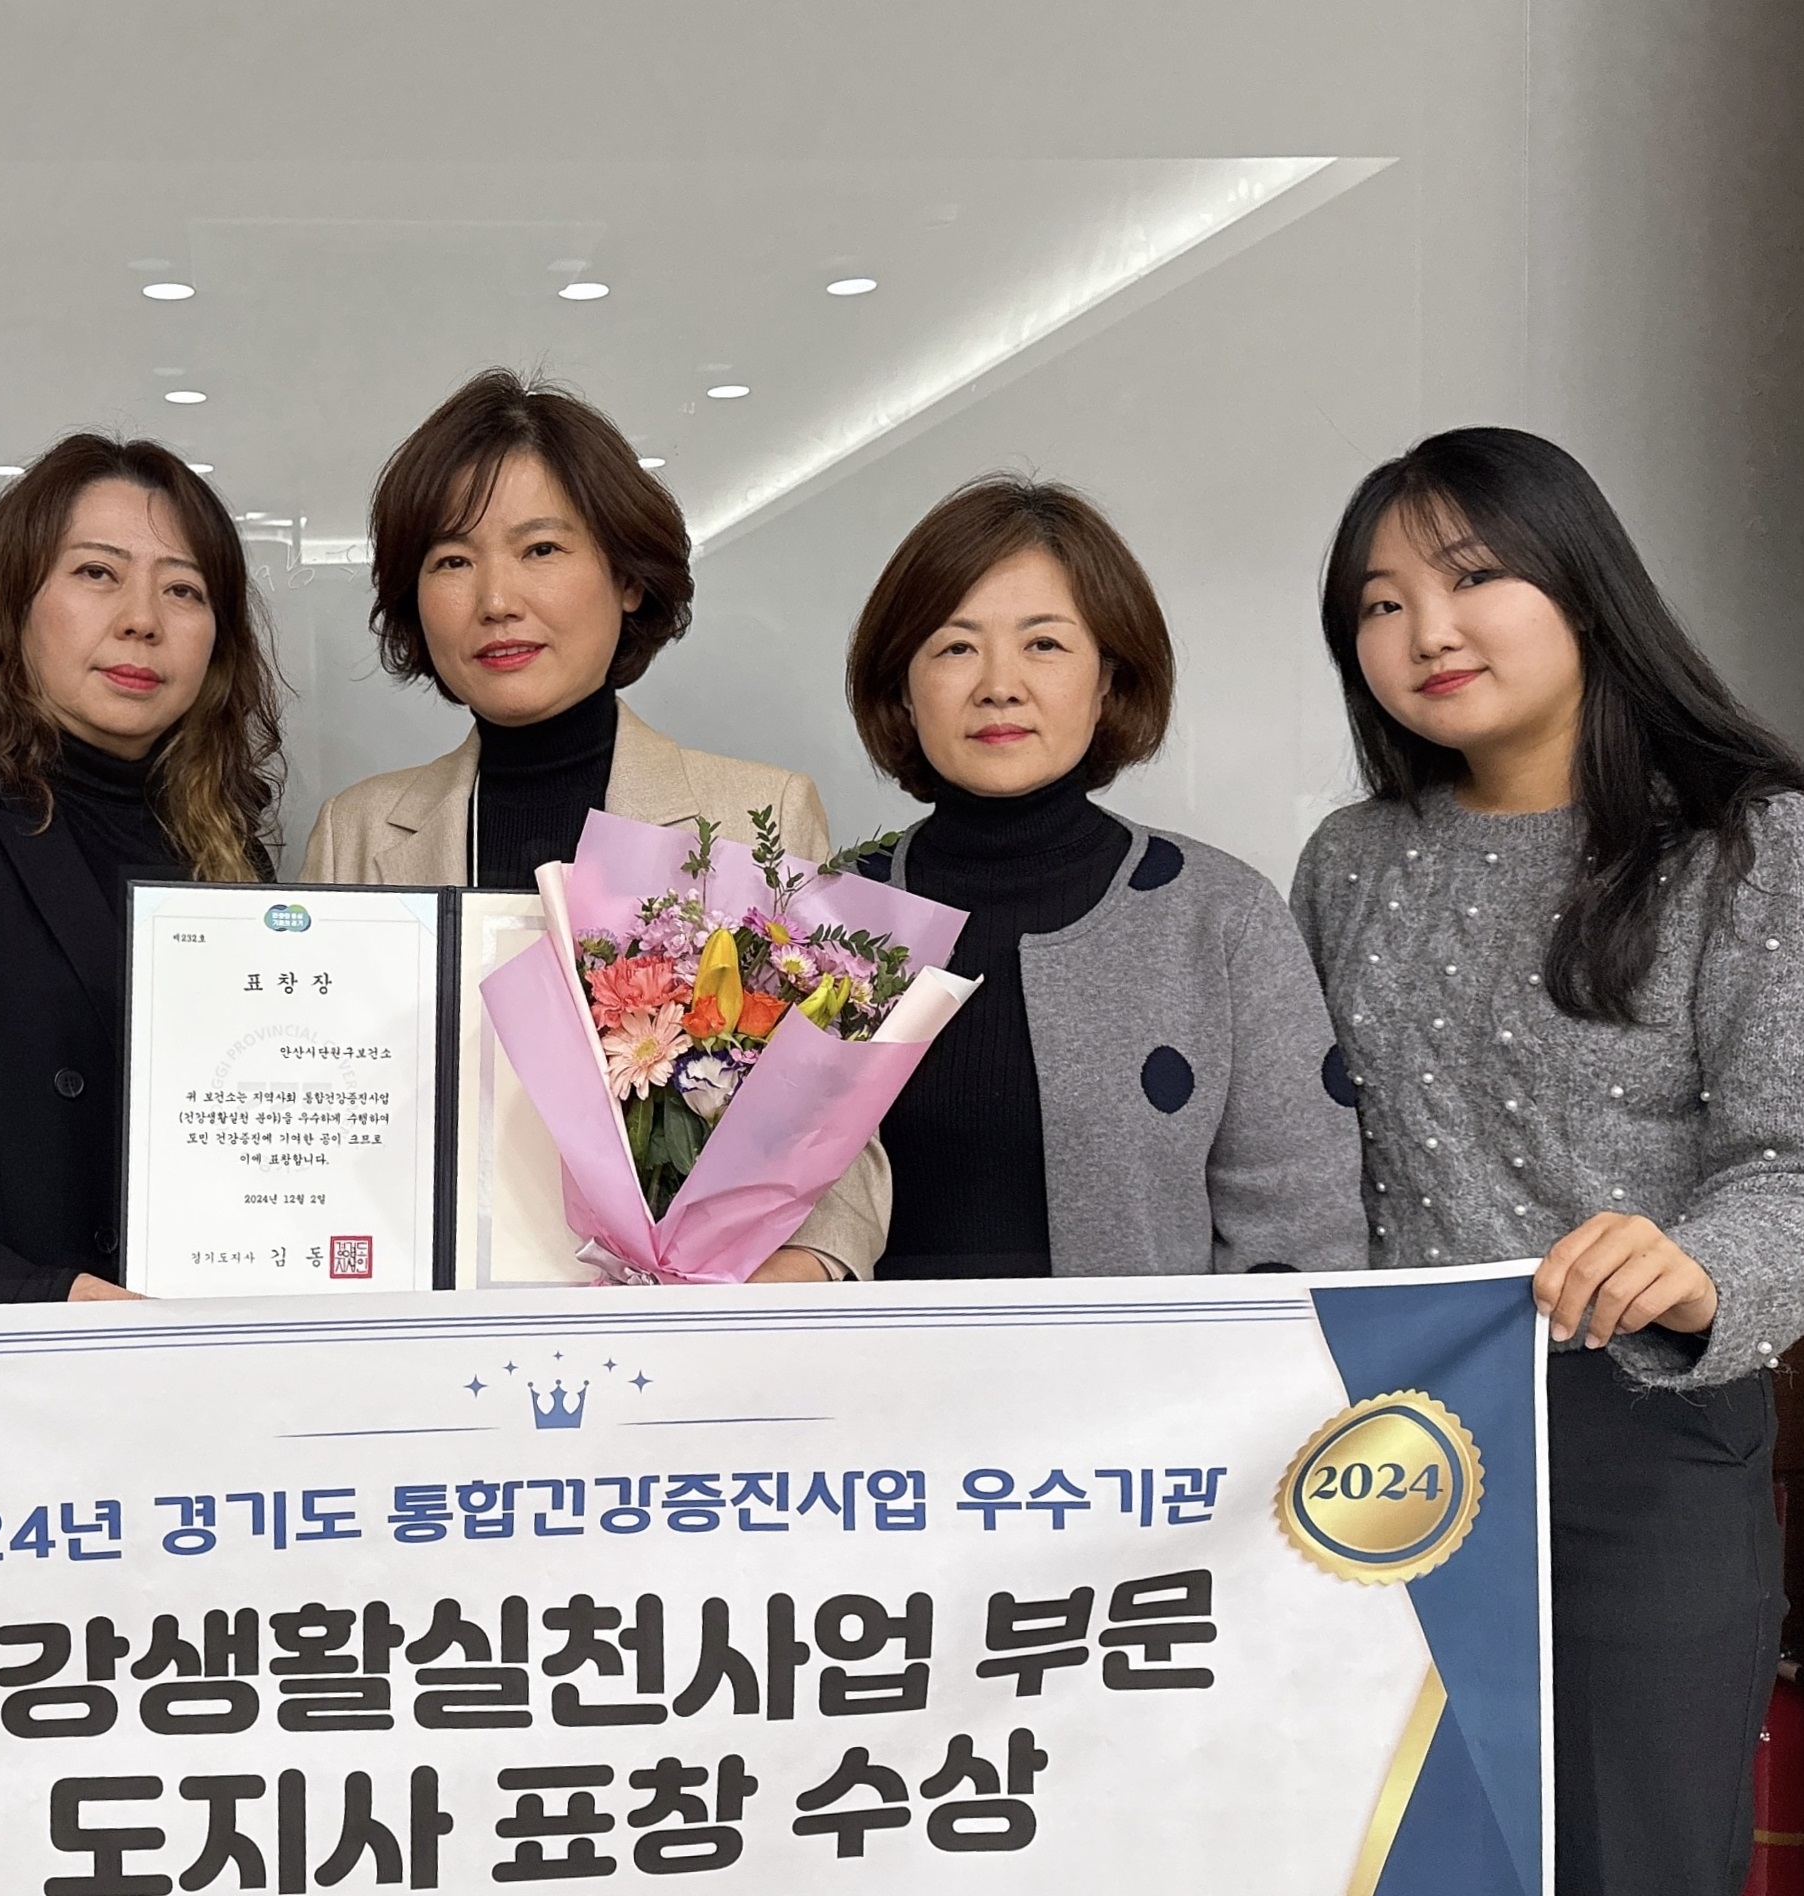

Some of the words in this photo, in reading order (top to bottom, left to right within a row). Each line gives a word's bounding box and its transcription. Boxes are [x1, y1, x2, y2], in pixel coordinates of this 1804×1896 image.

[203, 1090, 248, 1104] 보건소는
[253, 1091, 297, 1105] 지역사회
[302, 1091, 390, 1105] 통합건강증진사업
[179, 1111, 249, 1125] (건강생활실천
[255, 1112, 293, 1125] 분야)을
[298, 1112, 341, 1125] 우수하게
[347, 1112, 390, 1125] 수행하여
[187, 1132, 209, 1145] 도민
[216, 1132, 272, 1146] 건강증진에
[279, 1132, 314, 1146] 기여한
[320, 1132, 341, 1146] 공이
[348, 1133, 383, 1145] 크므로
[240, 1153, 262, 1165] 이에
[268, 1153, 330, 1166] 표창합니다.
[244, 1194, 278, 1205] 2024년
[283, 1194, 305, 1205] 12월
[310, 1194, 326, 1205] 2일
[1308, 1462, 1444, 1501] 2024
[154, 1488, 363, 1556] 경기도
[387, 1469, 926, 1544] 통합건강증진사업
[956, 1467, 1227, 1532] 우수기관
[976, 1569, 1218, 1697] 부문
[43, 1764, 455, 1896] 도지사
[491, 1753, 759, 1883] 표창
[792, 1727, 1049, 1860] 수상
